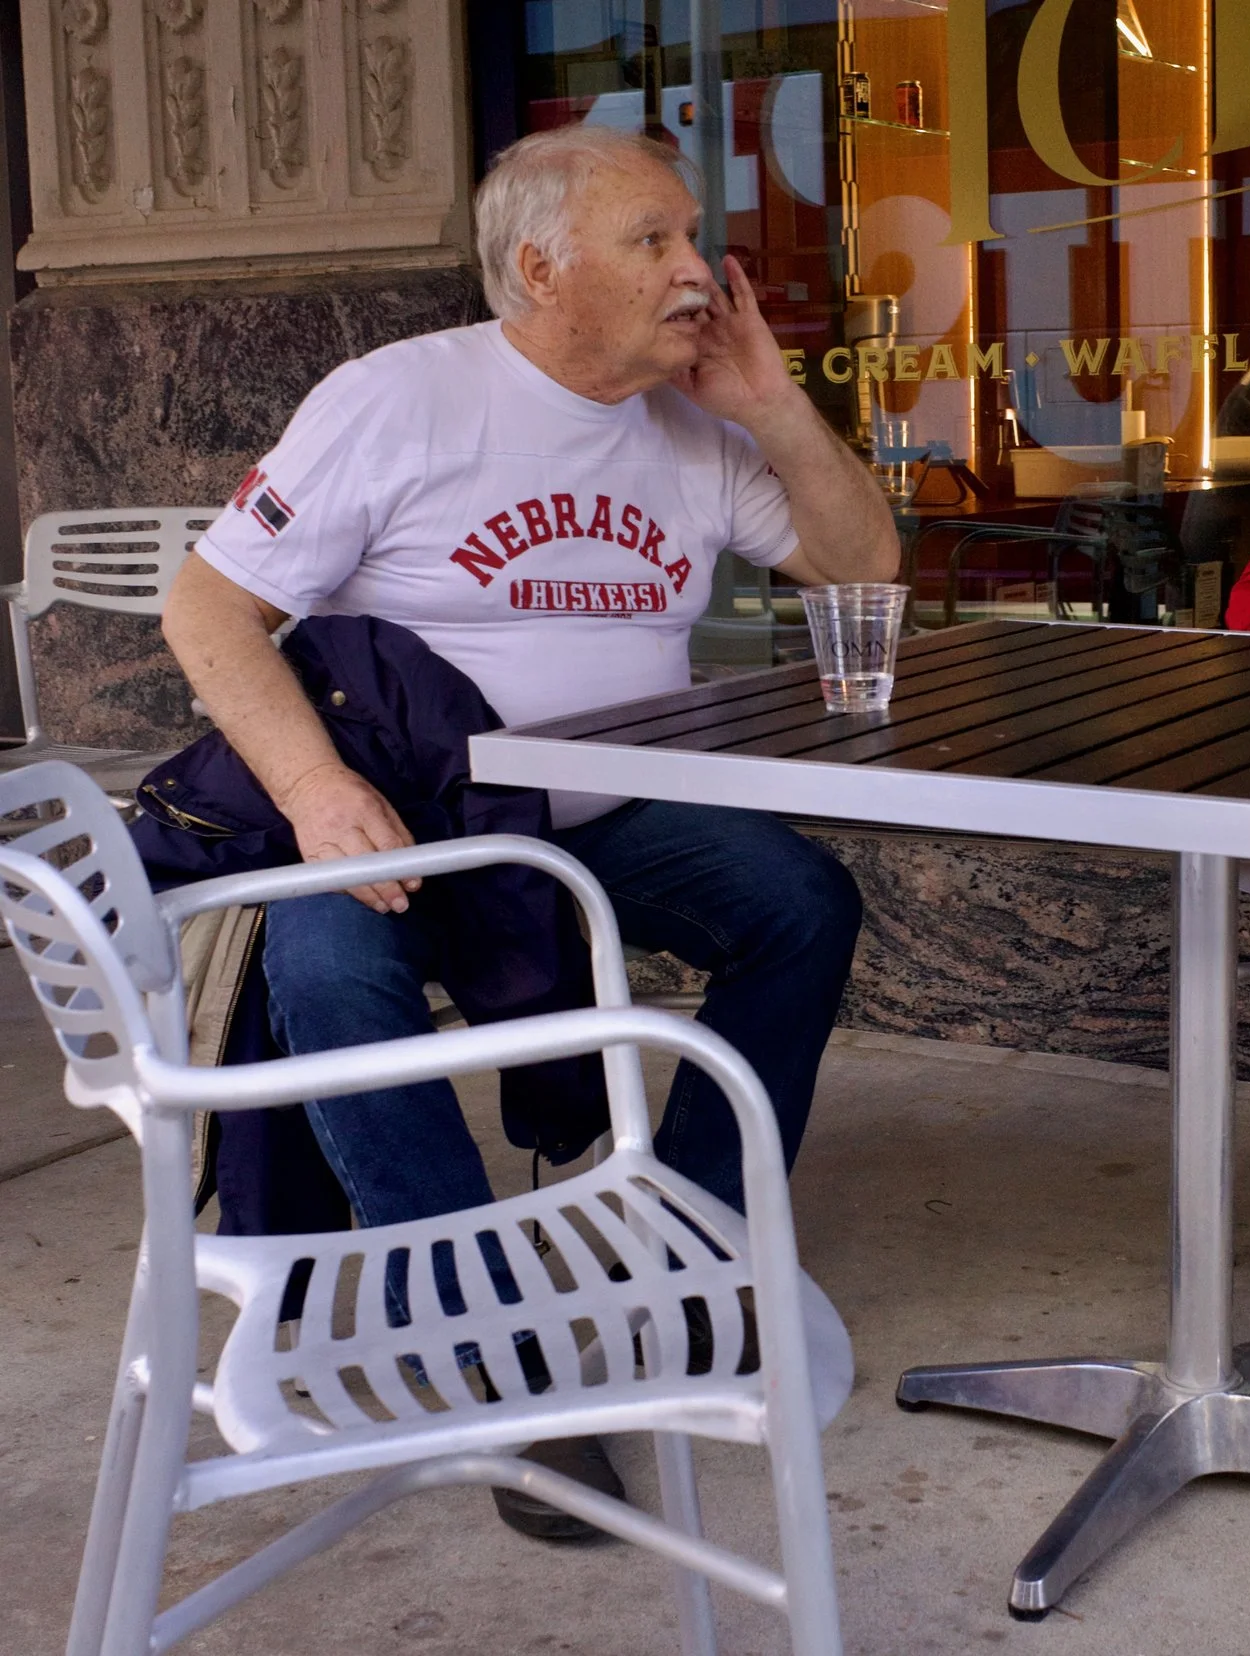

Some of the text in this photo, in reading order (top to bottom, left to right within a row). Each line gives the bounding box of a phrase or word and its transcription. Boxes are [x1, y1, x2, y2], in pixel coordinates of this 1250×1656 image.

[822, 342, 1005, 384] CREAM
[449, 493, 693, 595] NEBRASKA
[529, 581, 653, 611] HUSKERS
